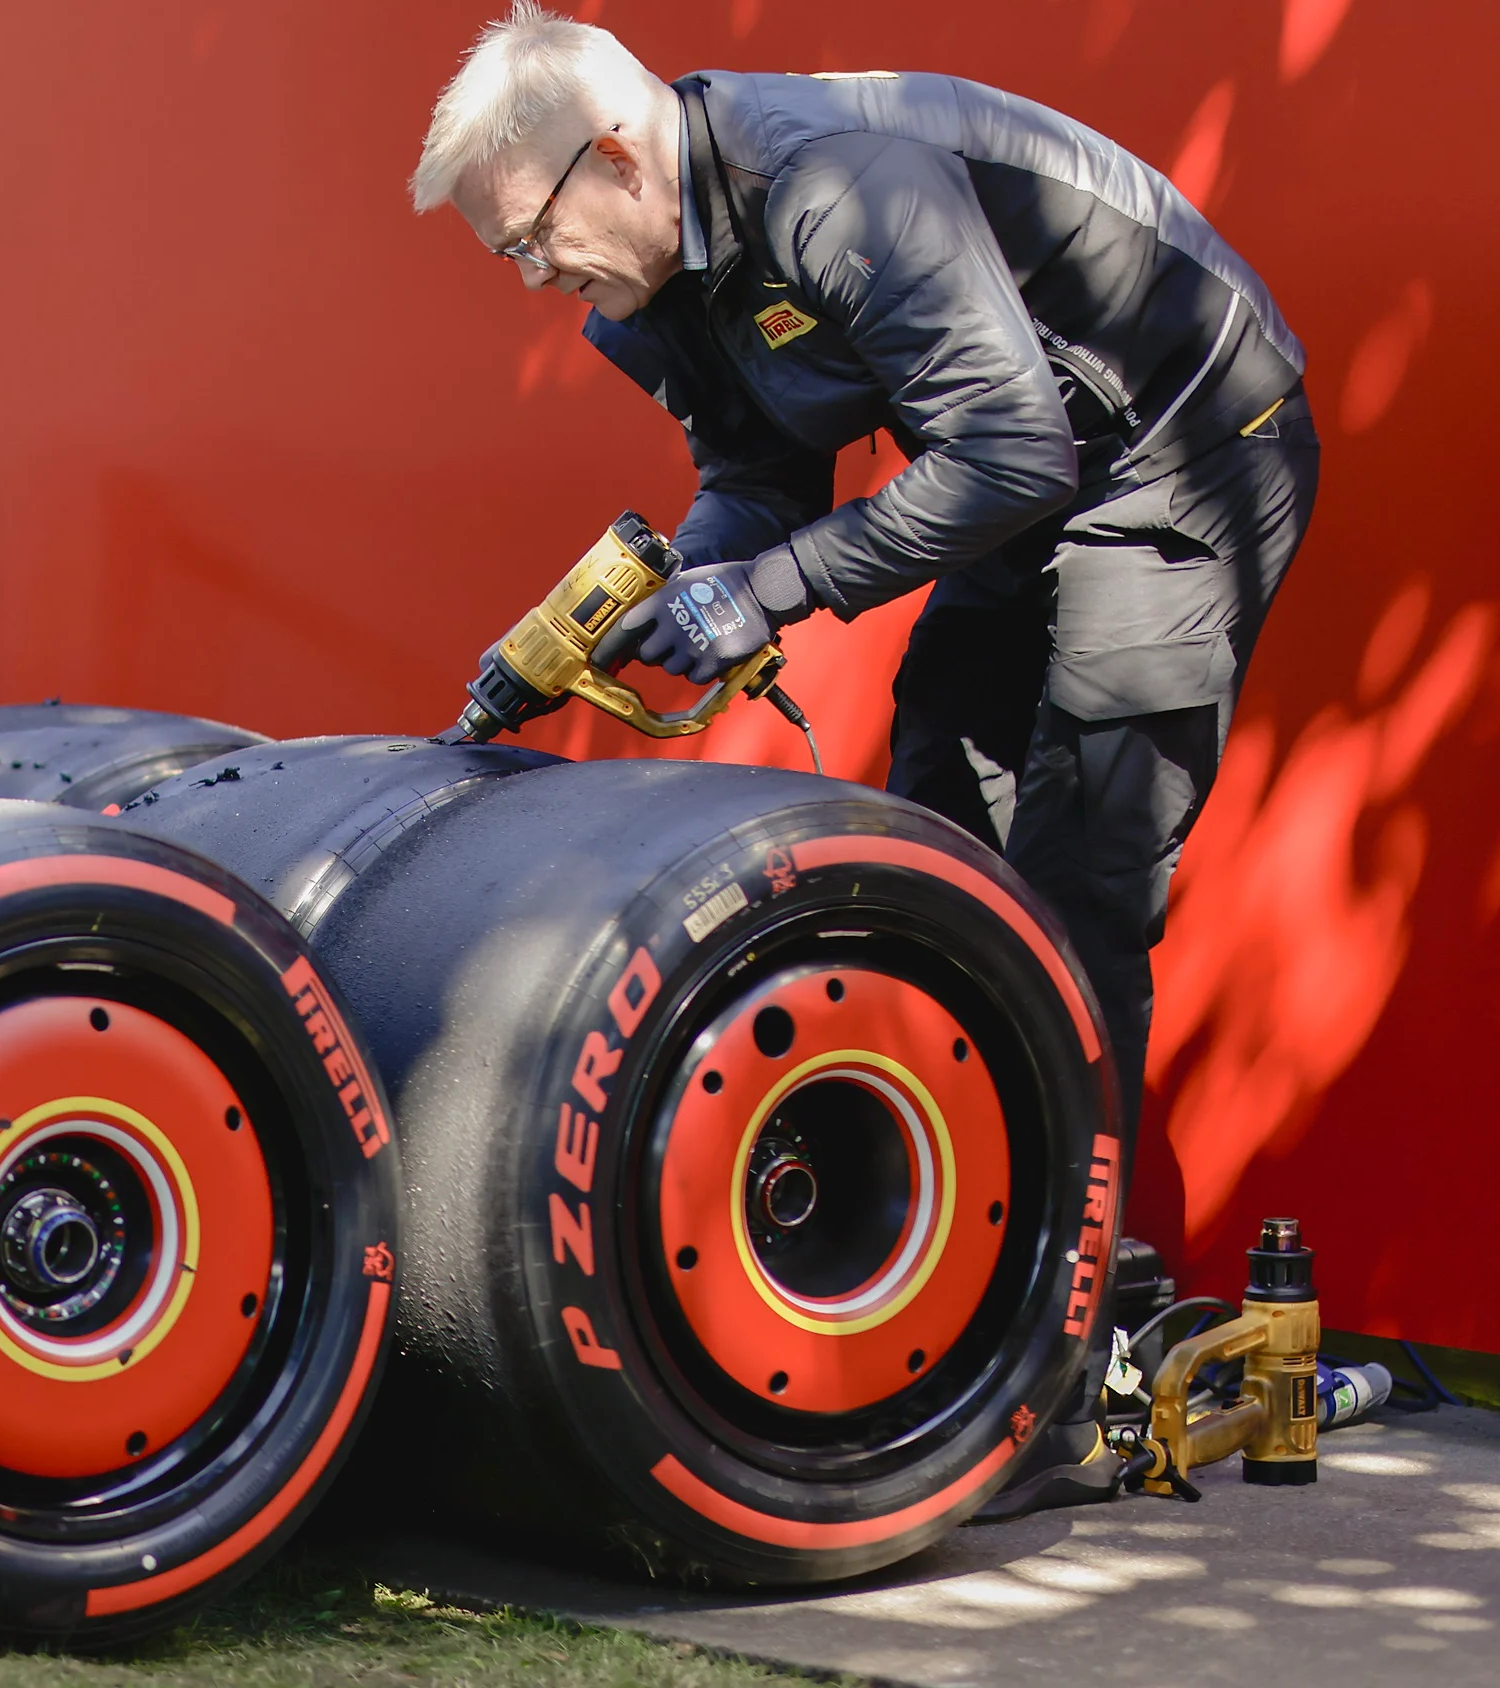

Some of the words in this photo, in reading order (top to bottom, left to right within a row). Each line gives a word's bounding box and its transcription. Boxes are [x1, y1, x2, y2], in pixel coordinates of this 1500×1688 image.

[759, 309, 804, 341] PIRELLI
[667, 596, 710, 652] uvex
[280, 954, 391, 1160] PIRELLI
[549, 945, 663, 1276] ZERO
[1063, 1133, 1120, 1341] PIRELLI
[561, 1306, 622, 1370] P
